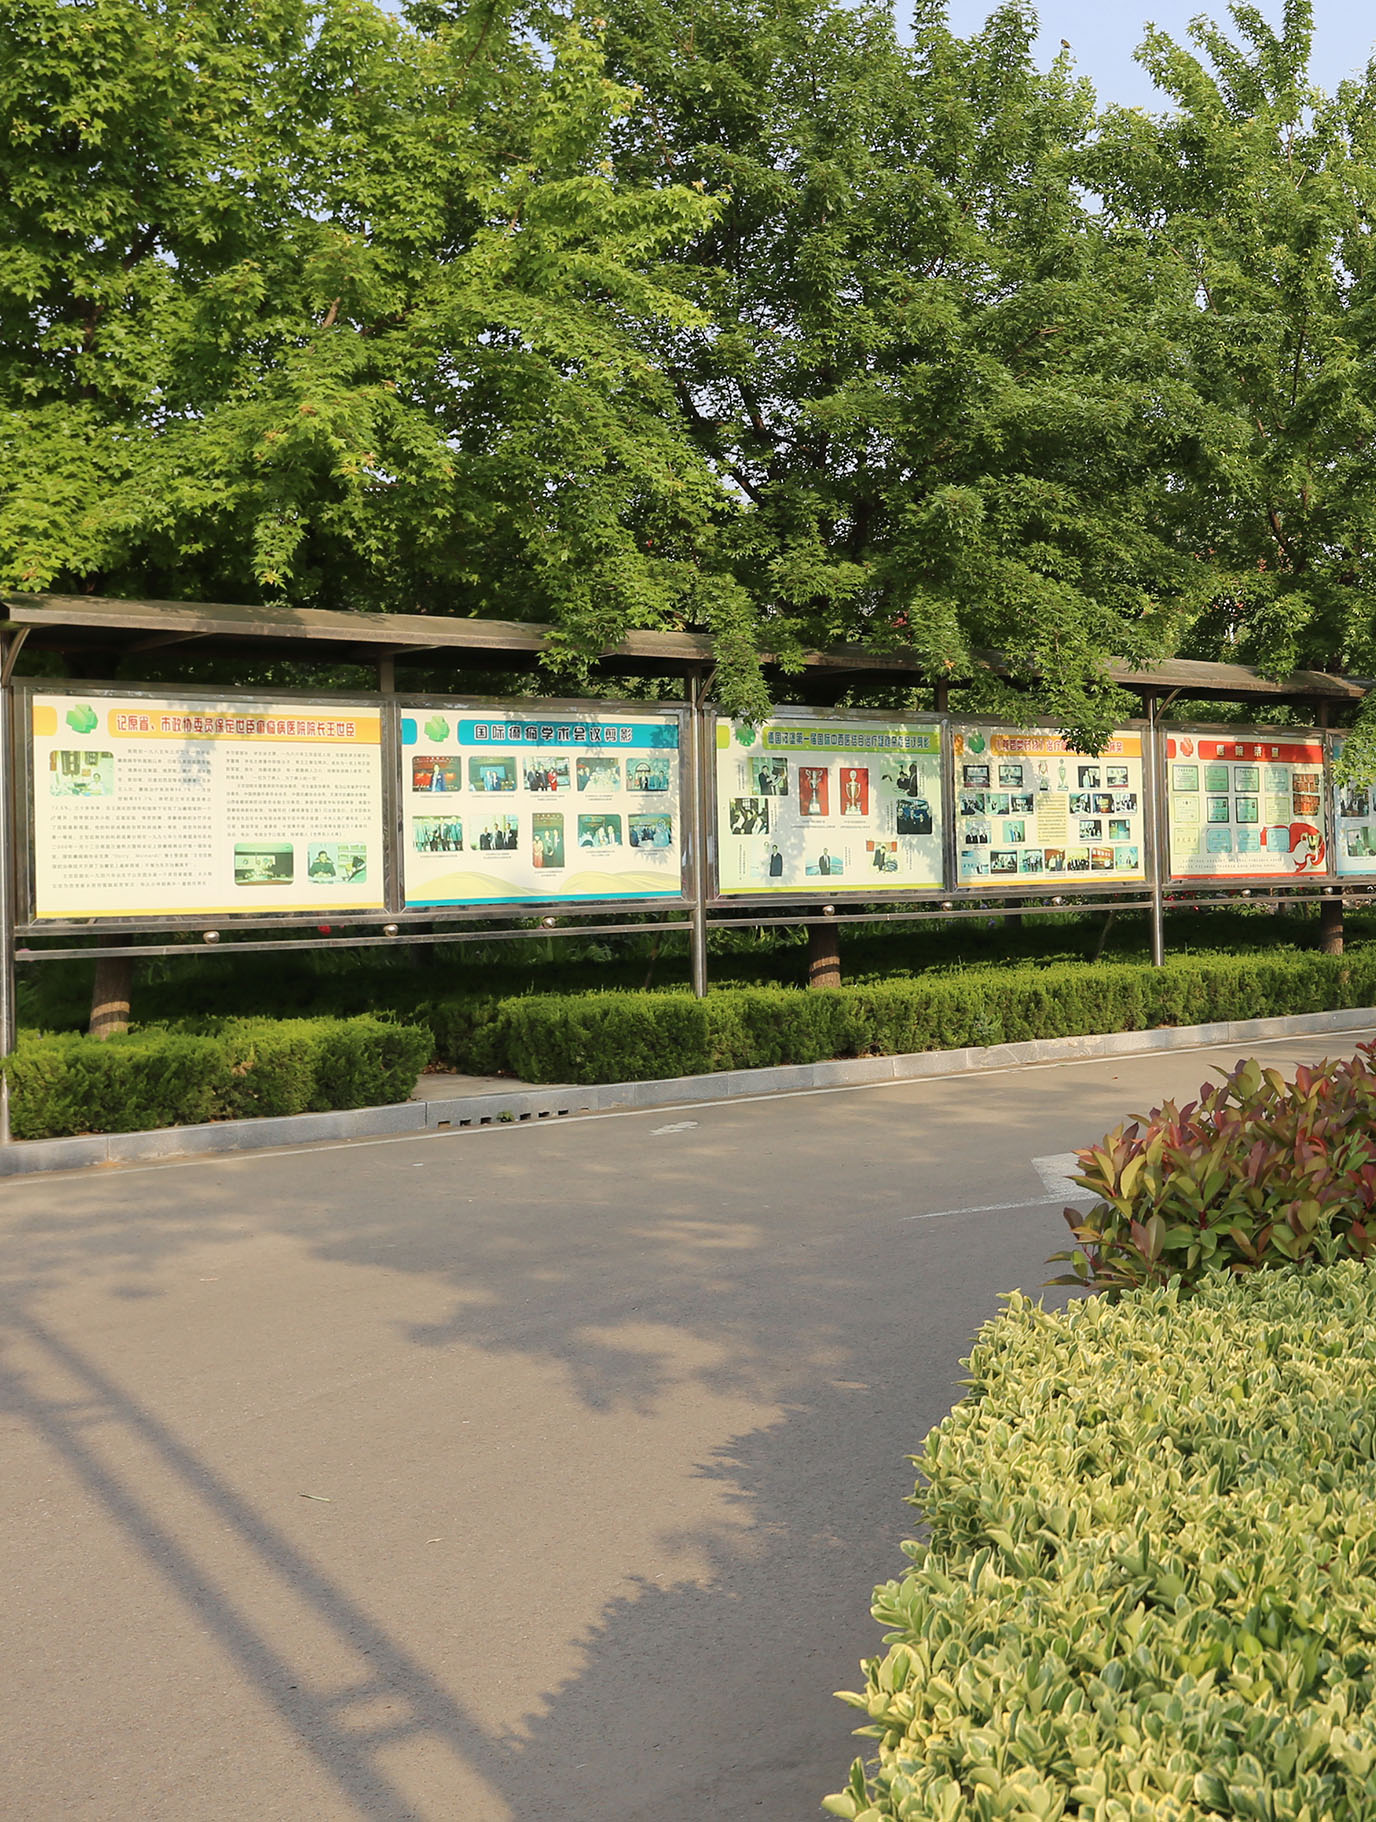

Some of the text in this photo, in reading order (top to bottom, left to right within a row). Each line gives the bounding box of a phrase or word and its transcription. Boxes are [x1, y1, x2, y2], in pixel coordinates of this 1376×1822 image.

[474, 724, 633, 743] 国际癫痫学术会议剪影
